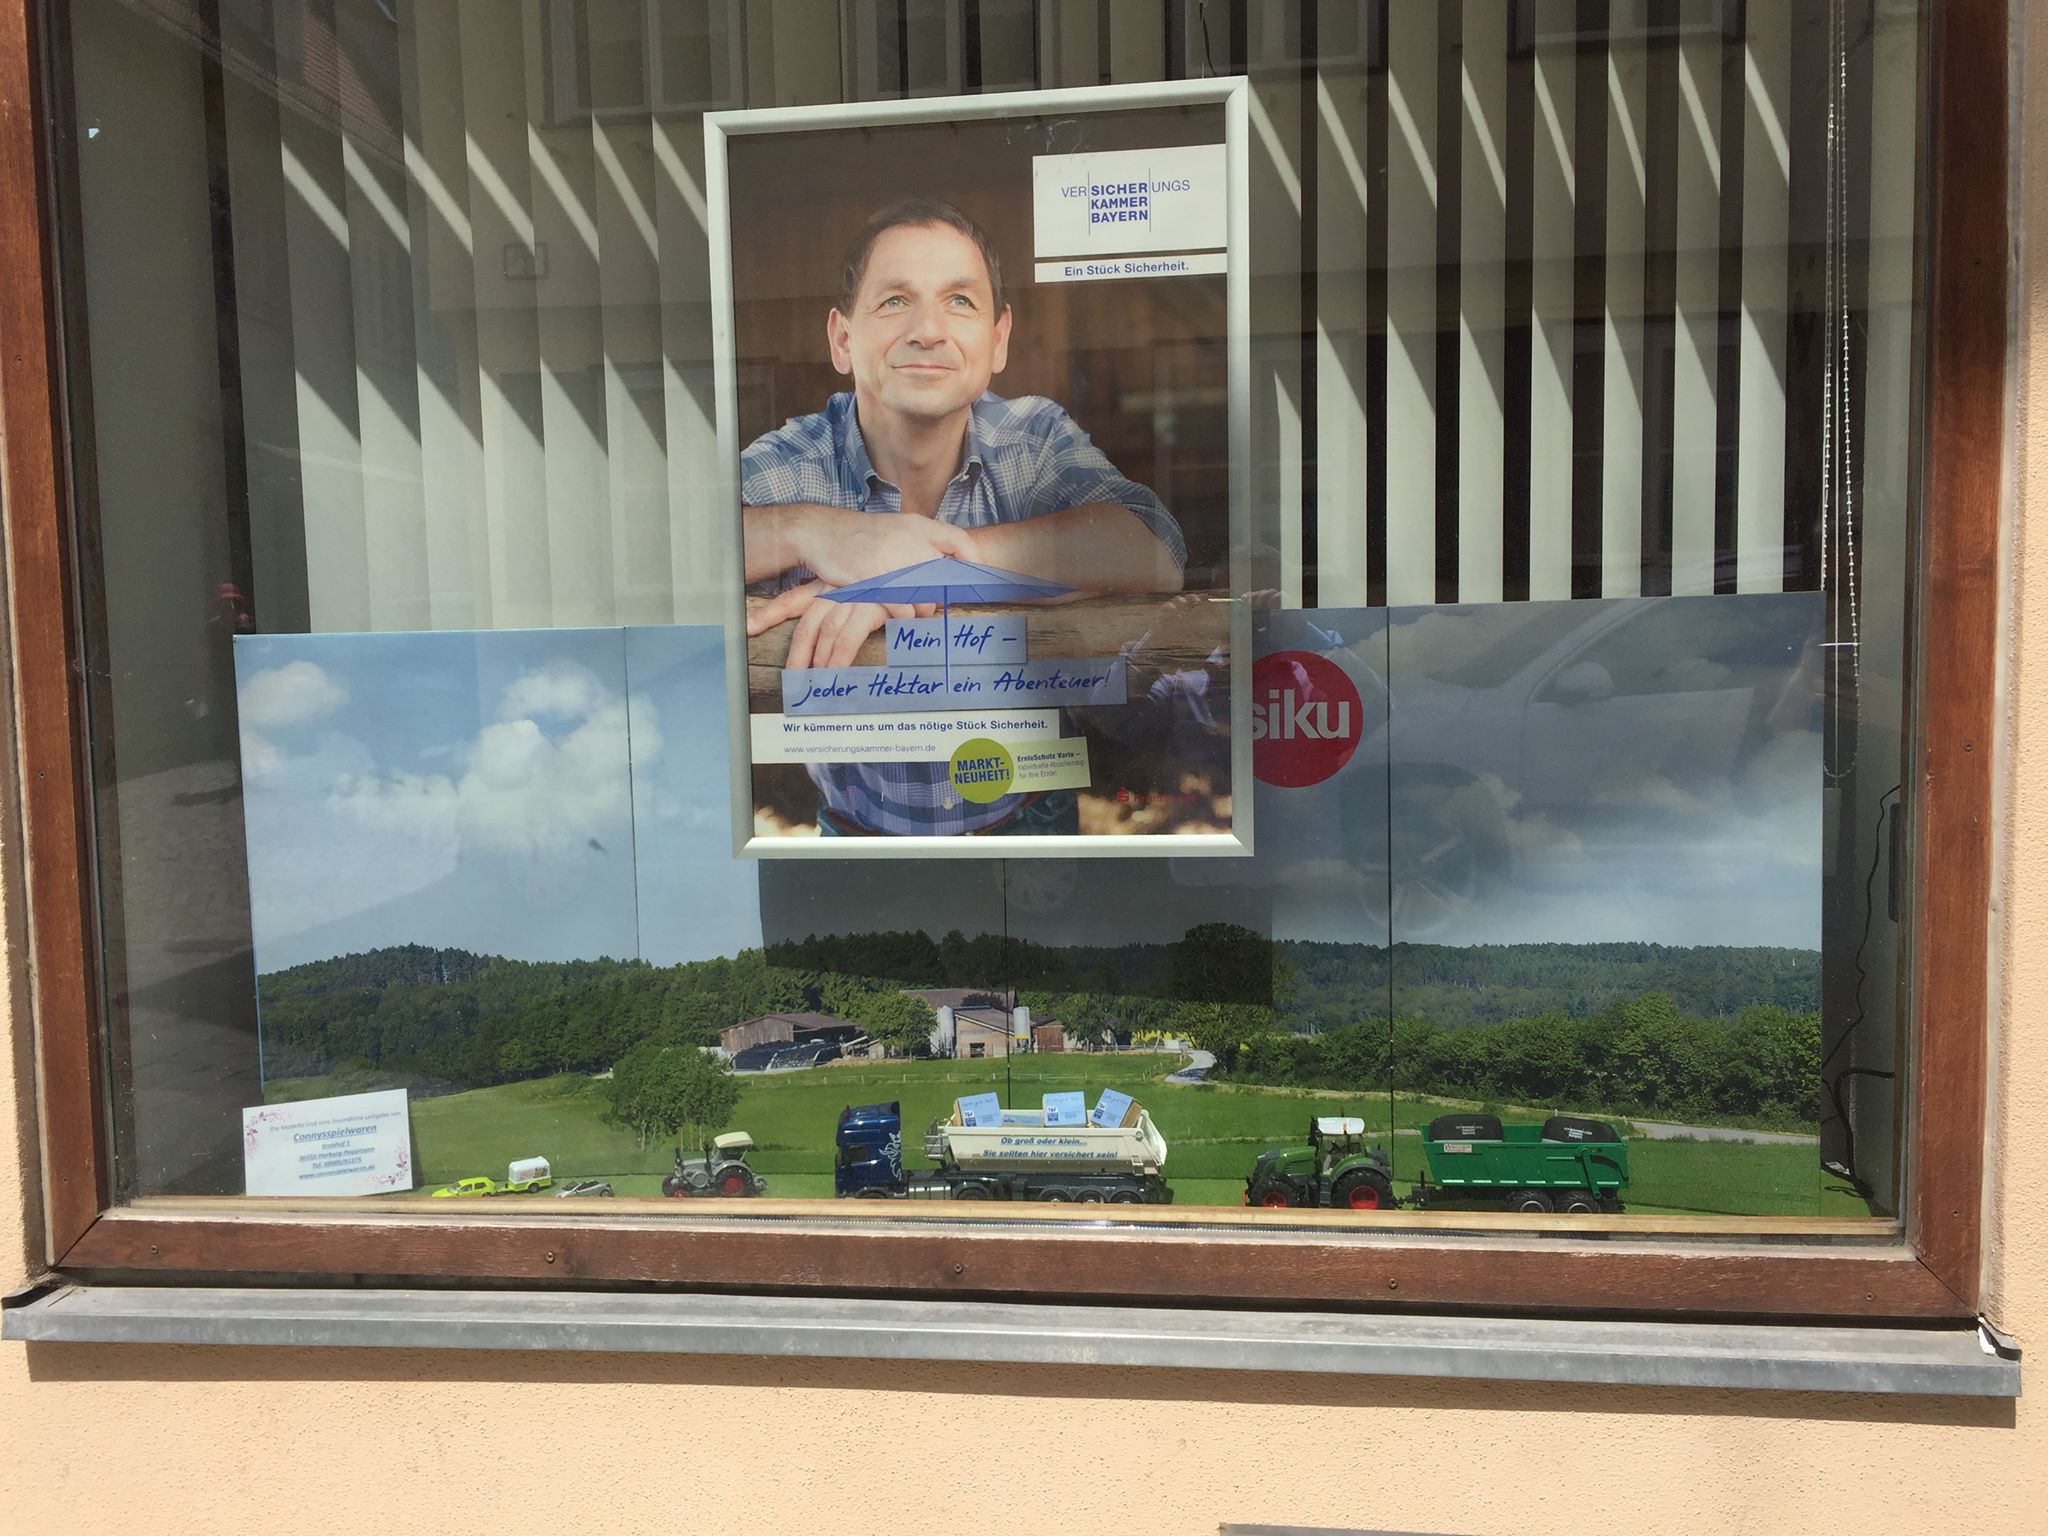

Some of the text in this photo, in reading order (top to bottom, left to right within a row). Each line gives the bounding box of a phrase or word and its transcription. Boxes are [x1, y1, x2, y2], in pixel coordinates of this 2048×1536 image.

[1091, 196, 1148, 210] KAMMER
[1091, 210, 1148, 223] BAYERN
[1064, 261, 1190, 276] Ein Stück Sicherheit.
[893, 626, 941, 650] Mein
[953, 624, 994, 655] Hof
[791, 668, 1111, 707] jeder Hektar ein Abenteuer!
[1252, 689, 1350, 740] siku
[783, 720, 1048, 732] Wir kümmern uns um das nötige Stück Sicherheit.
[784, 743, 936, 755] www.versicherungskammer-bayern.de
[957, 757, 1005, 772] MARKT-
[954, 769, 1010, 784] NEUHEIT!
[293, 1125, 377, 1142] Connysspielwaren
[1015, 1136, 1034, 1145] groß
[1036, 1137, 1056, 1145] oder
[983, 1149, 997, 1157] Sie
[1050, 1150, 1094, 1158] versichert
[1097, 1150, 1118, 1159] sein!
